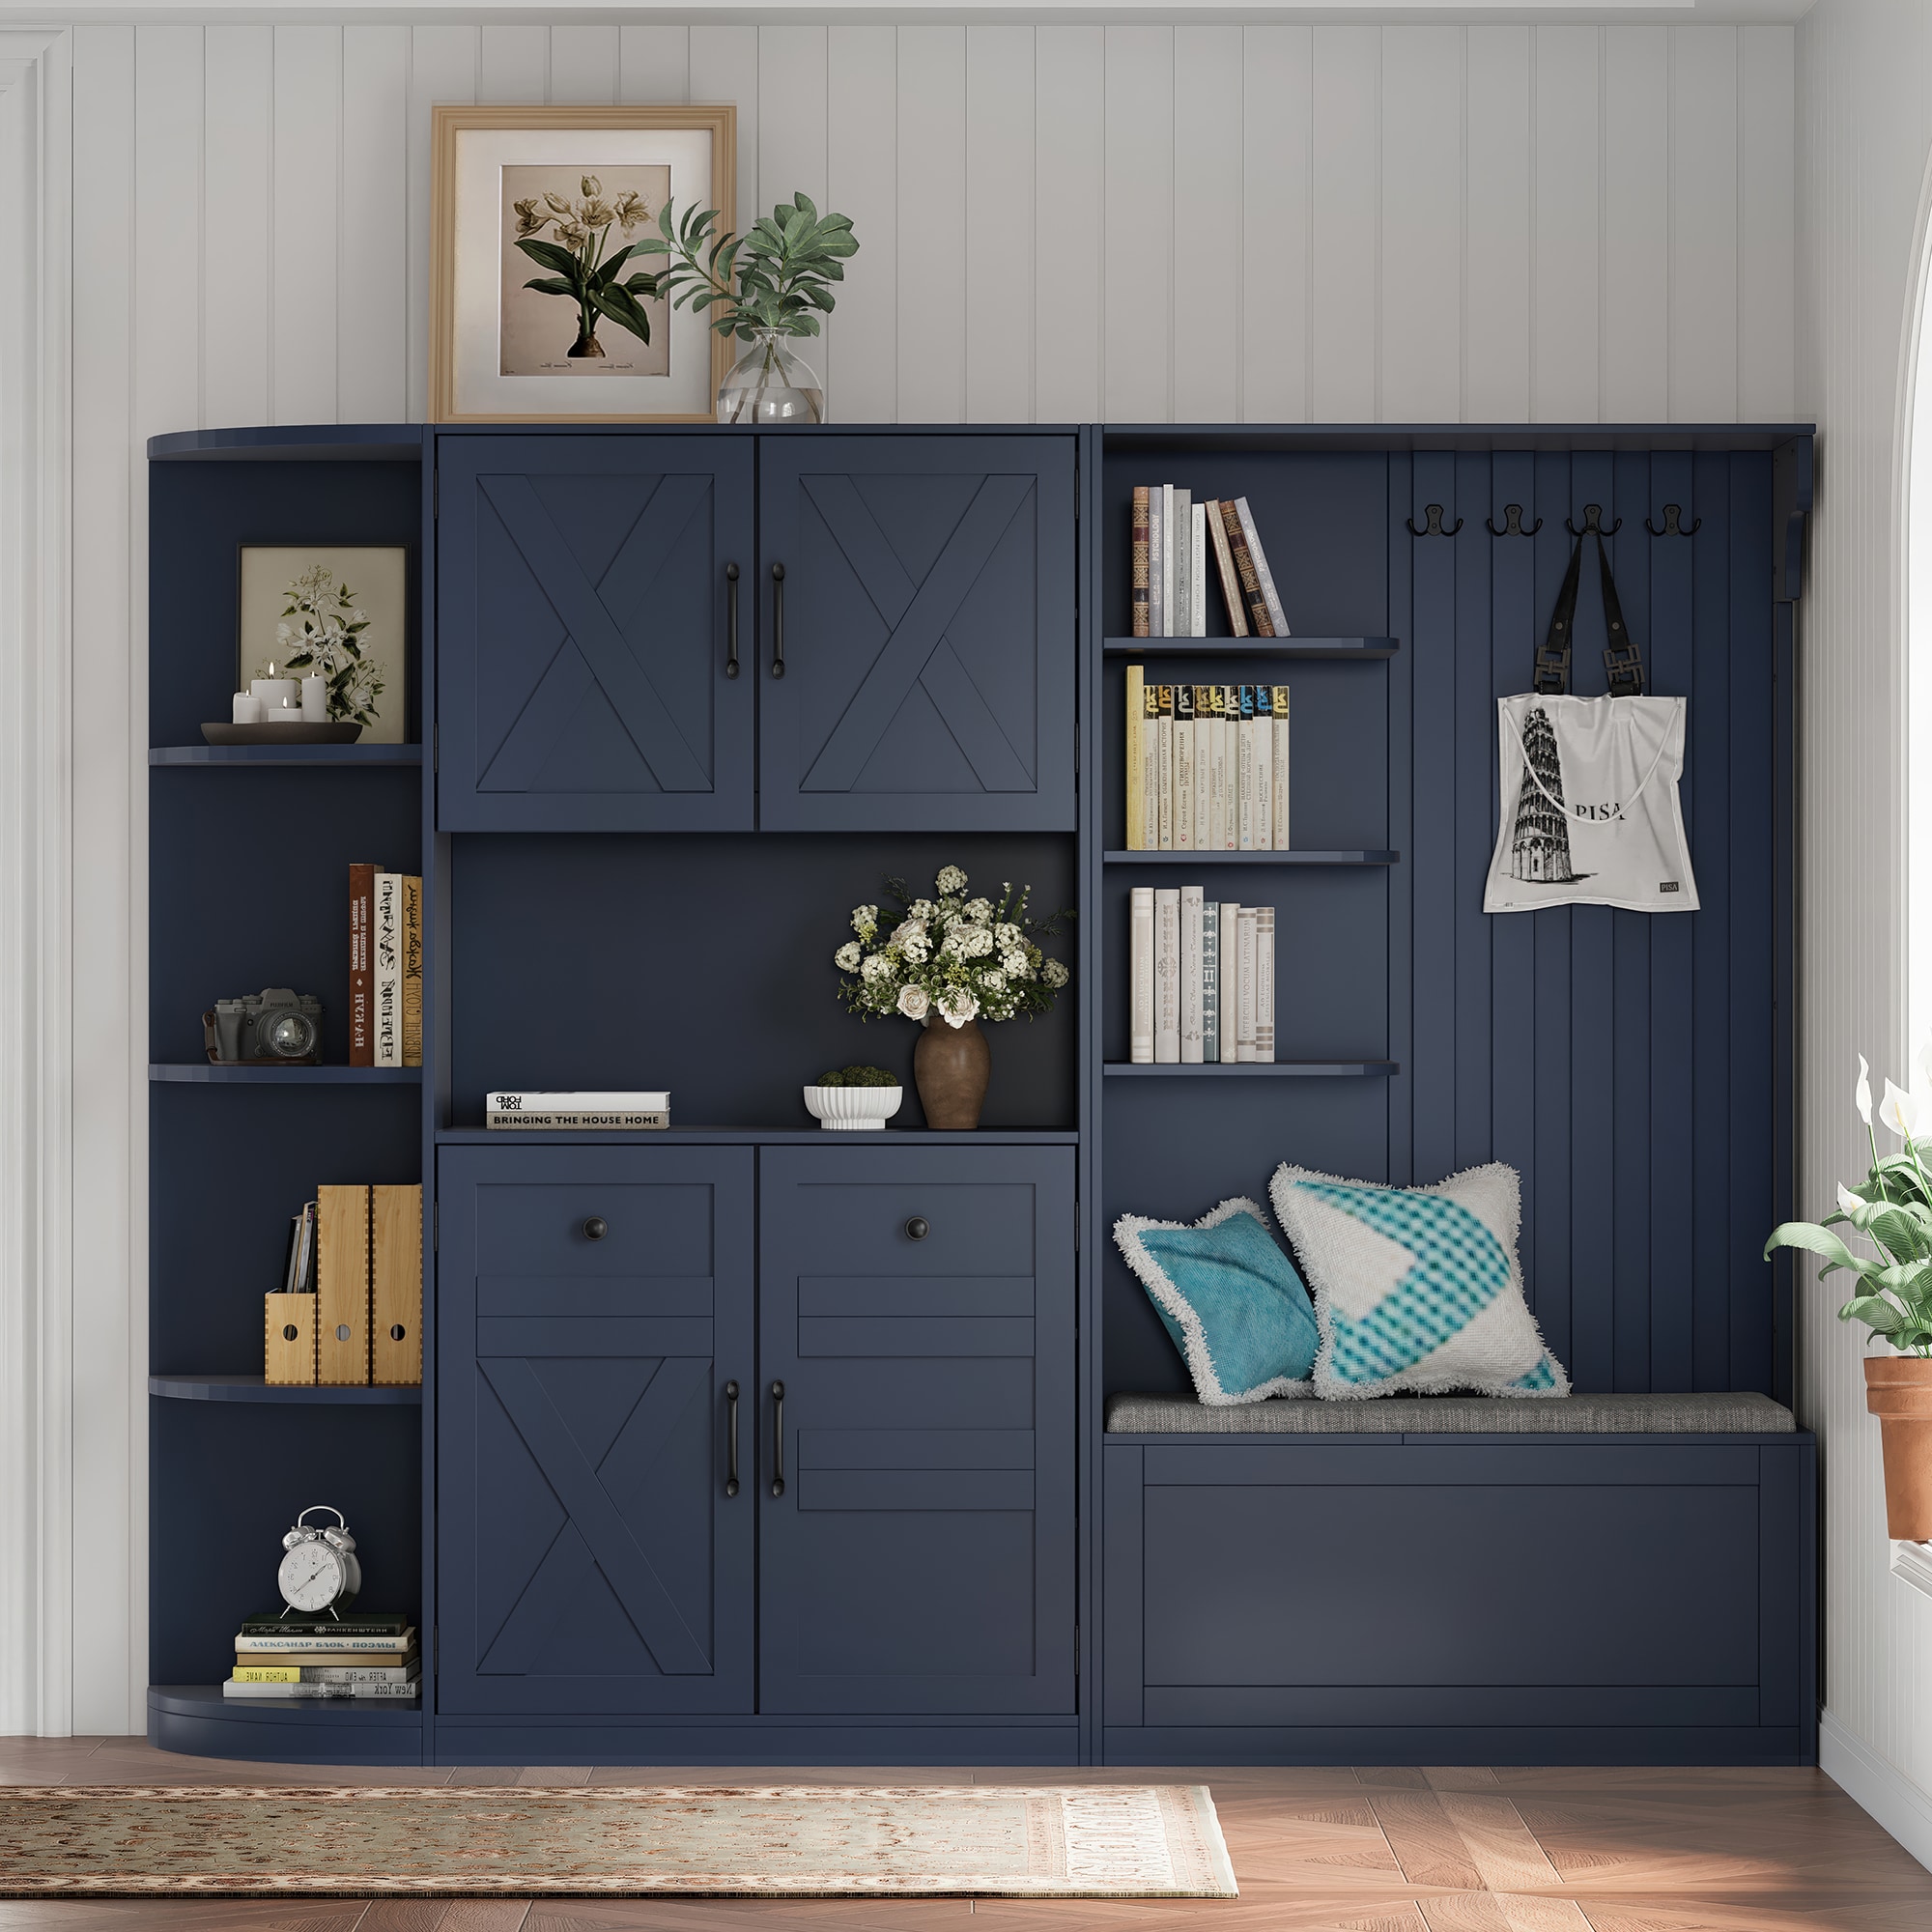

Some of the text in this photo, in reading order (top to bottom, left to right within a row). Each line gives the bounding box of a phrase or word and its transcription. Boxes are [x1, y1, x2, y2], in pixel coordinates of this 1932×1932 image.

[1575, 803, 1627, 820] PISA
[1661, 883, 1678, 892] PISA
[494, 1116, 659, 1124] BRINGING THE HOUSE HOME
